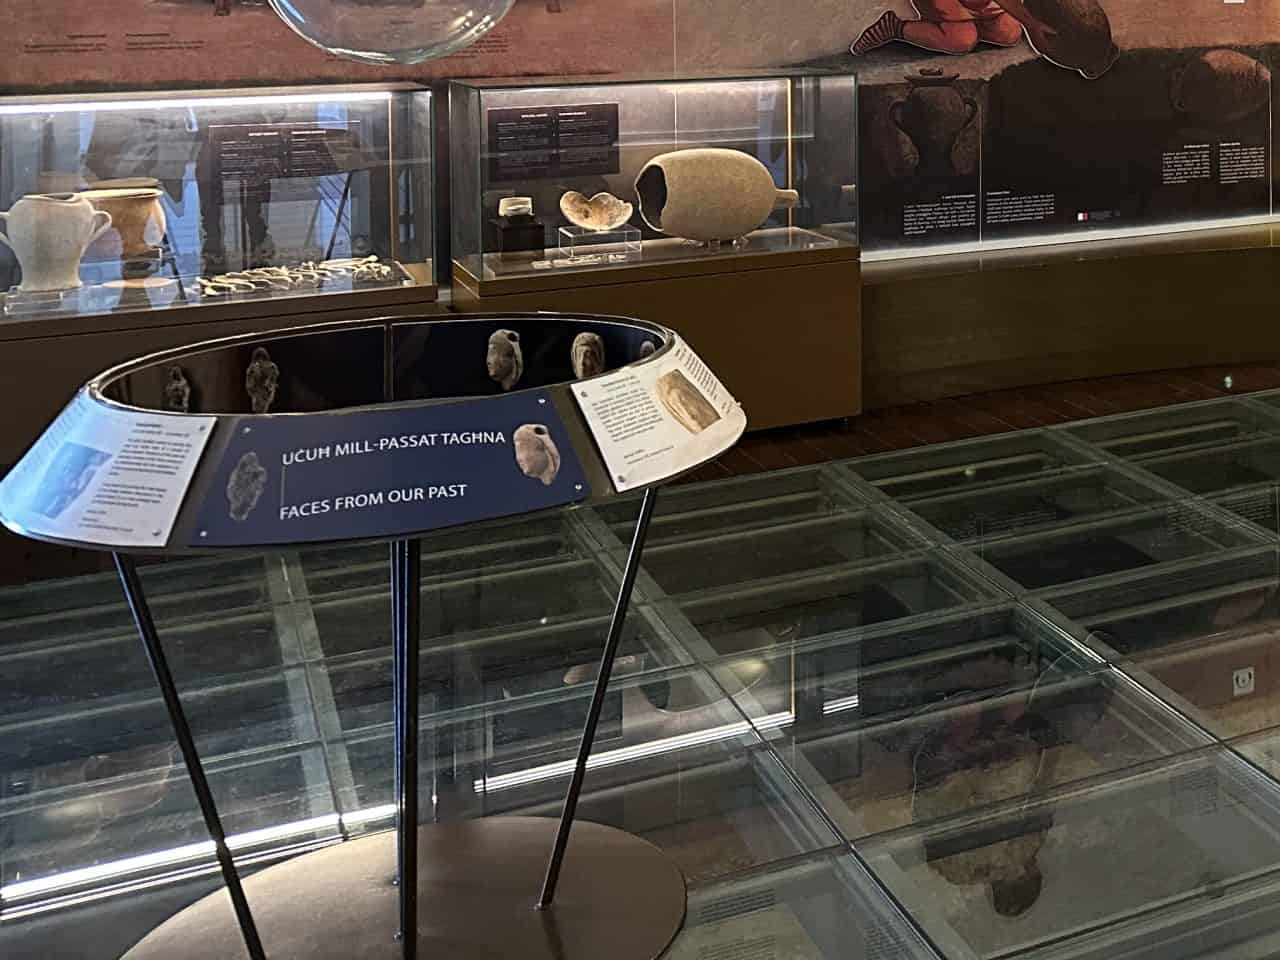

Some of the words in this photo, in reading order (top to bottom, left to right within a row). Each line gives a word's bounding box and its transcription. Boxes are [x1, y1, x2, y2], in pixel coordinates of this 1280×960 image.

[335, 434, 439, 456] MILL-PASSAT
[279, 500, 330, 520] FACES
[335, 492, 383, 510] FROM
[388, 489, 424, 503] OUR
[428, 484, 467, 498] PAST
